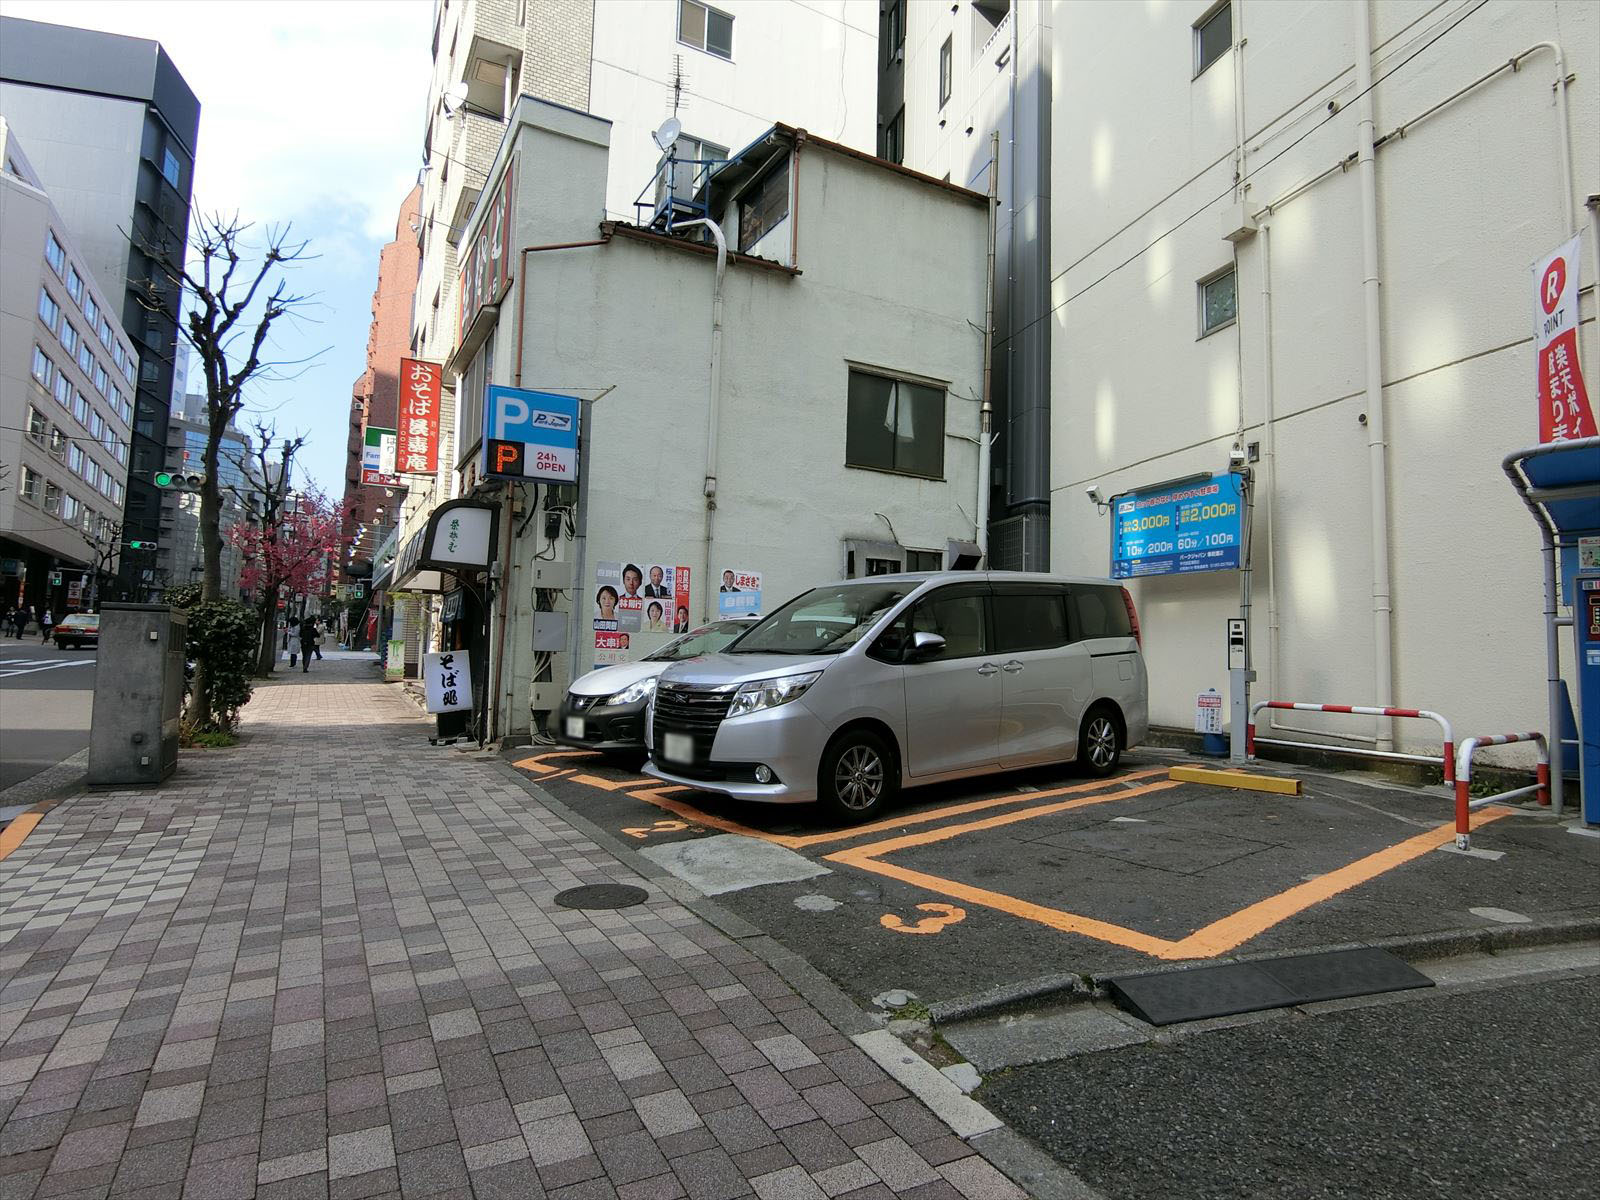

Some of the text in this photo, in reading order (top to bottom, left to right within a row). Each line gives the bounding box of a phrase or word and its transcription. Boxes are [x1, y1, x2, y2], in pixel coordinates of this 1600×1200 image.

[1547, 270, 1557, 304] R
[495, 396, 529, 440] P
[496, 444, 518, 472] P
[536, 461, 566, 473] OPEN
[537, 451, 557, 461] 24h
[1132, 514, 1170, 531] 3,000円
[1190, 502, 1236, 522] 2,000円
[880, 903, 966, 934] 3
